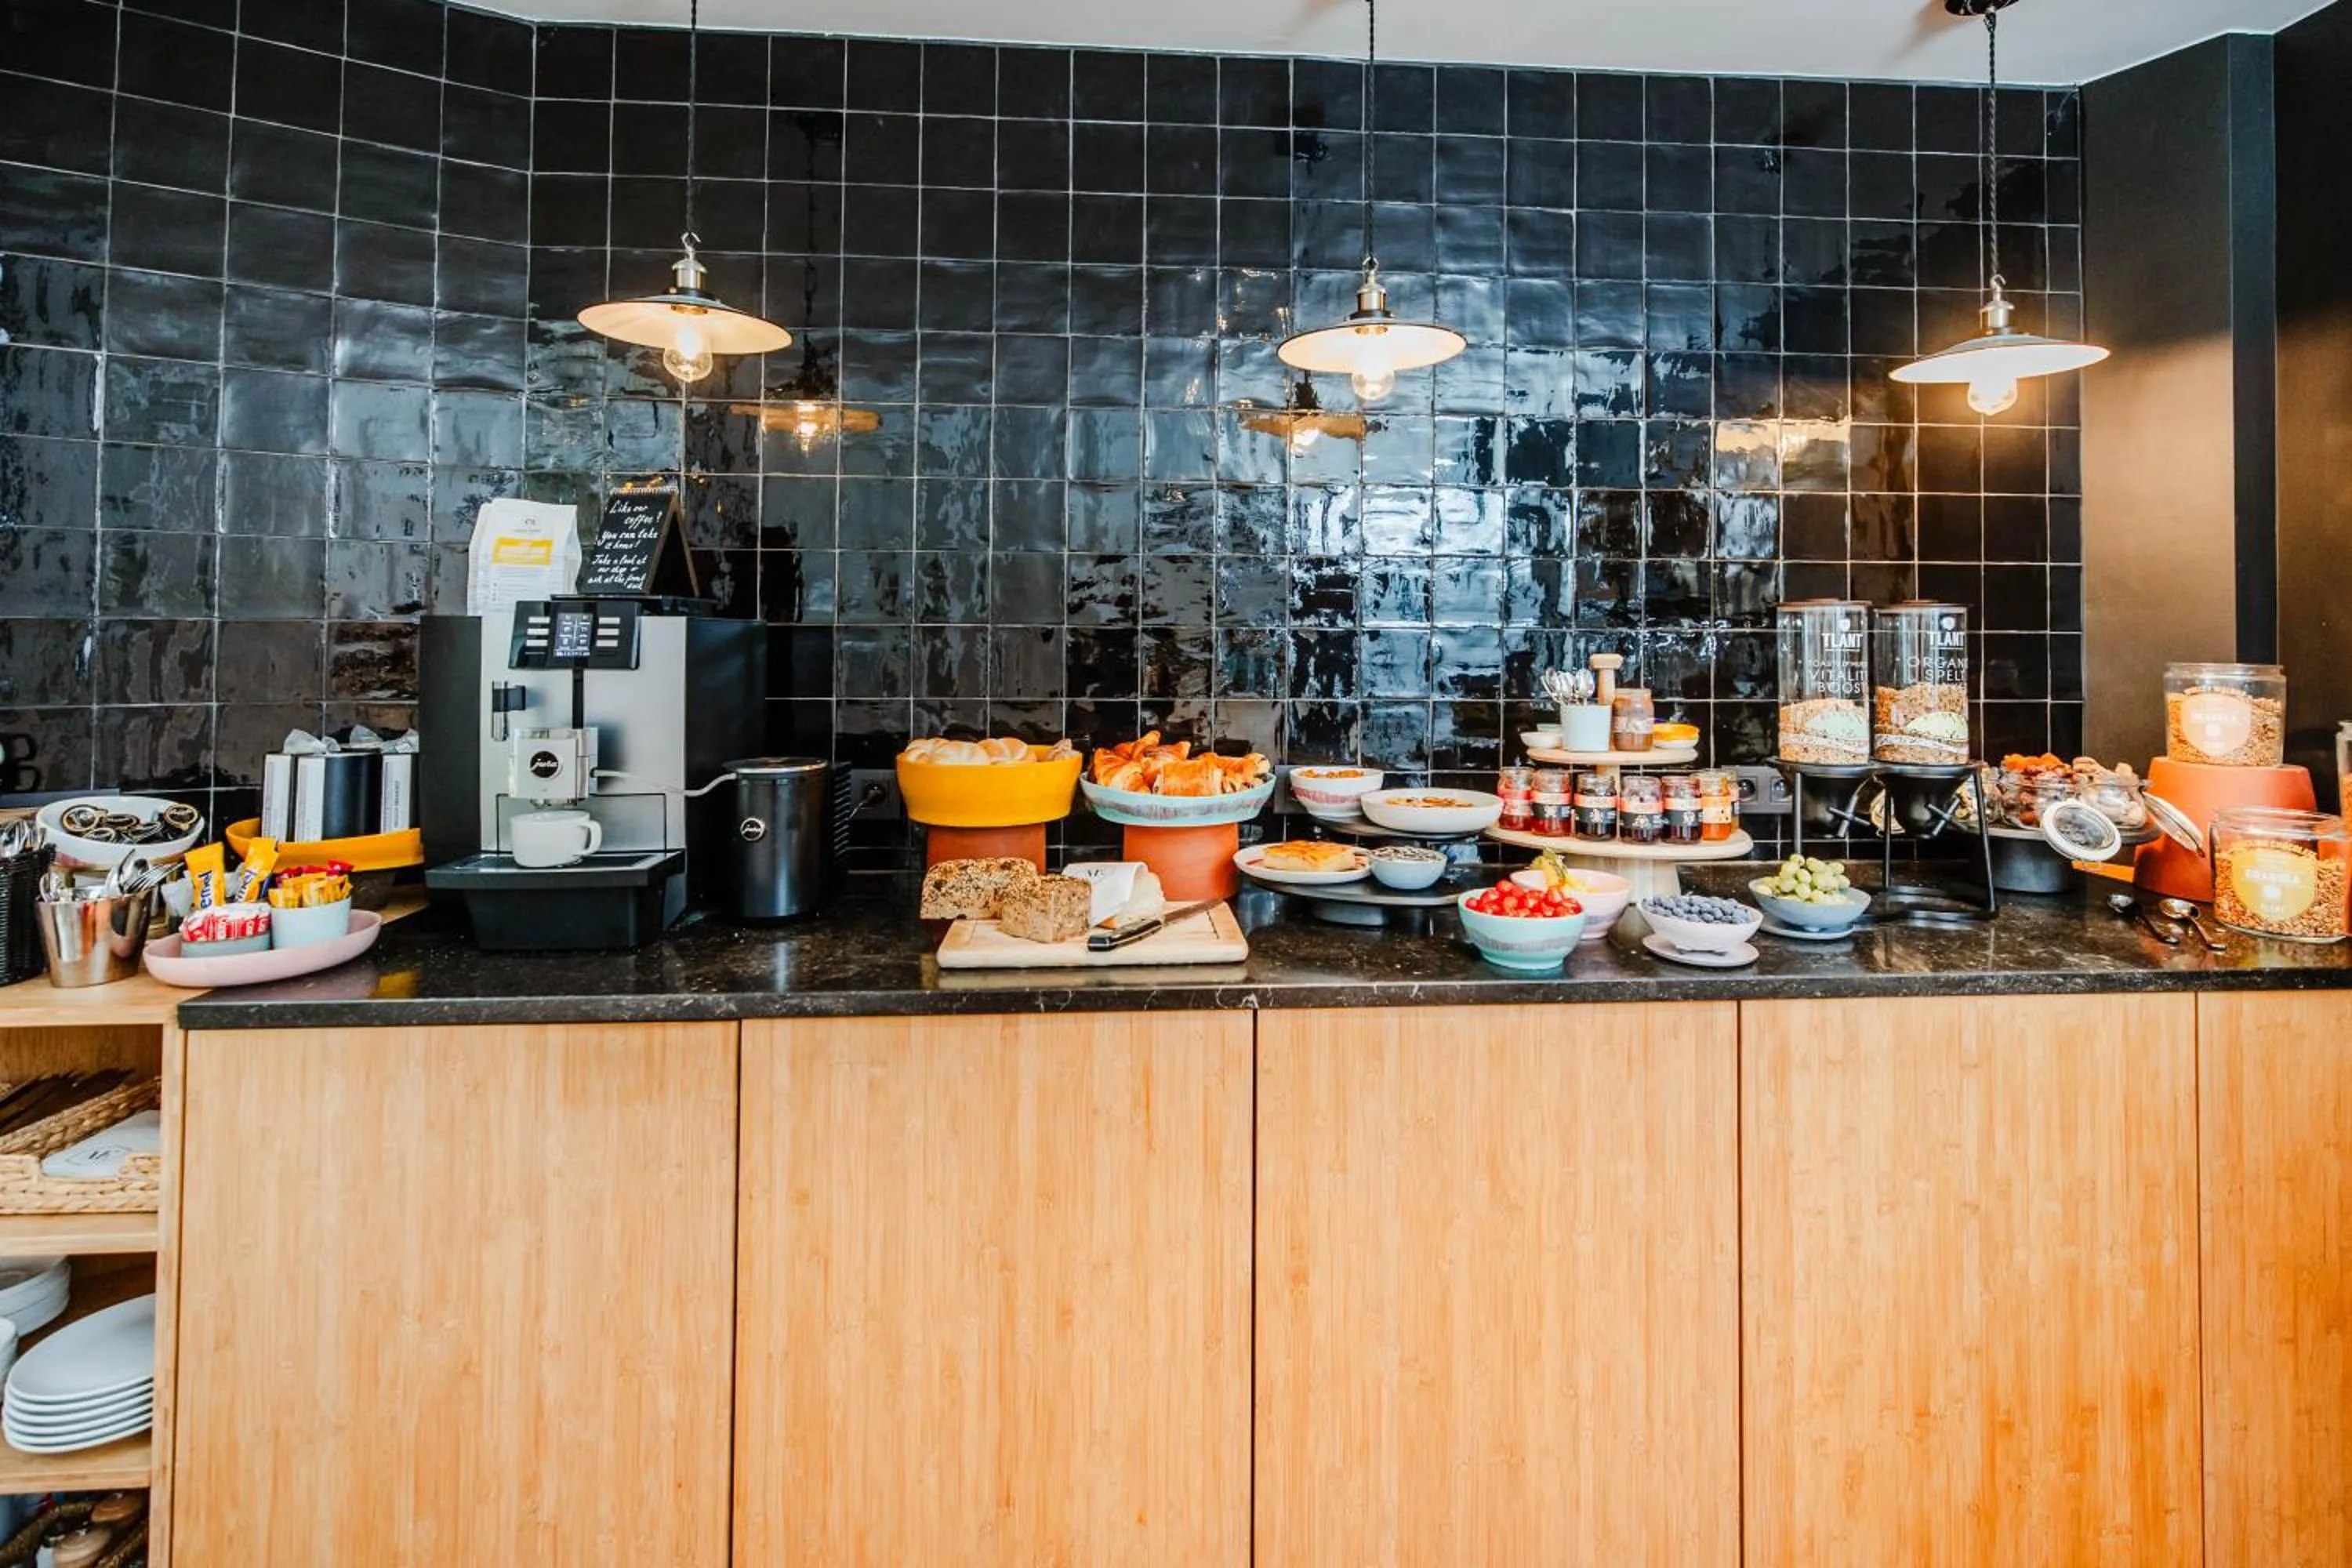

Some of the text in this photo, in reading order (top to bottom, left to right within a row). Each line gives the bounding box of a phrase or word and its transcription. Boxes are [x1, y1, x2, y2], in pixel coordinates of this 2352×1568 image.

[609, 500, 631, 514] Like
[637, 528, 658, 539] take
[592, 554, 612, 565] Take
[619, 554, 637, 565] look
[636, 554, 648, 565] at
[1809, 670, 1868, 681] VITALIT
